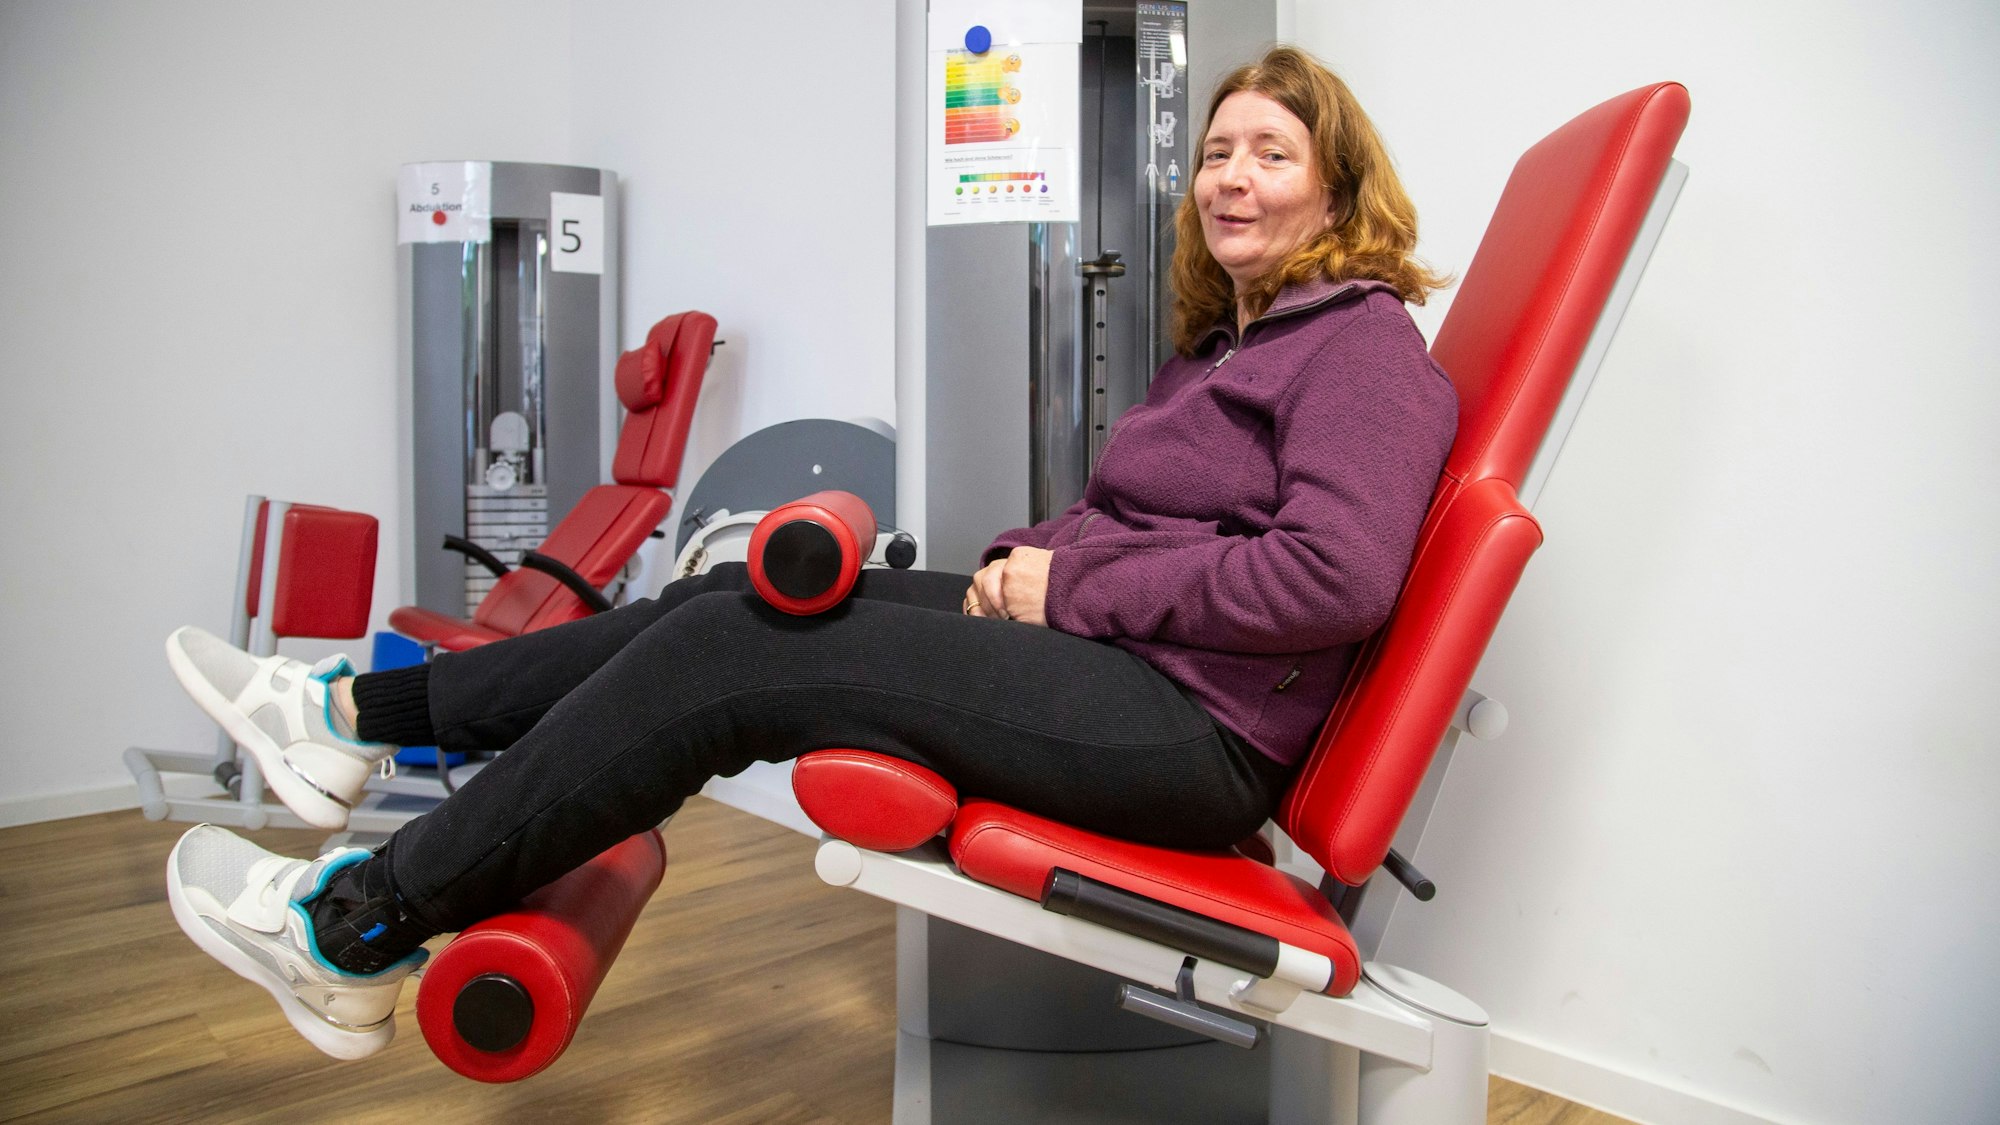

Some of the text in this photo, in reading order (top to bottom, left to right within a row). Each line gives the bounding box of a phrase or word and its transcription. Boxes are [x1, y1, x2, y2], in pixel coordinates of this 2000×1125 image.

[431, 183, 440, 195] 5
[409, 202, 463, 213] Abduktion
[560, 219, 582, 254] 5
